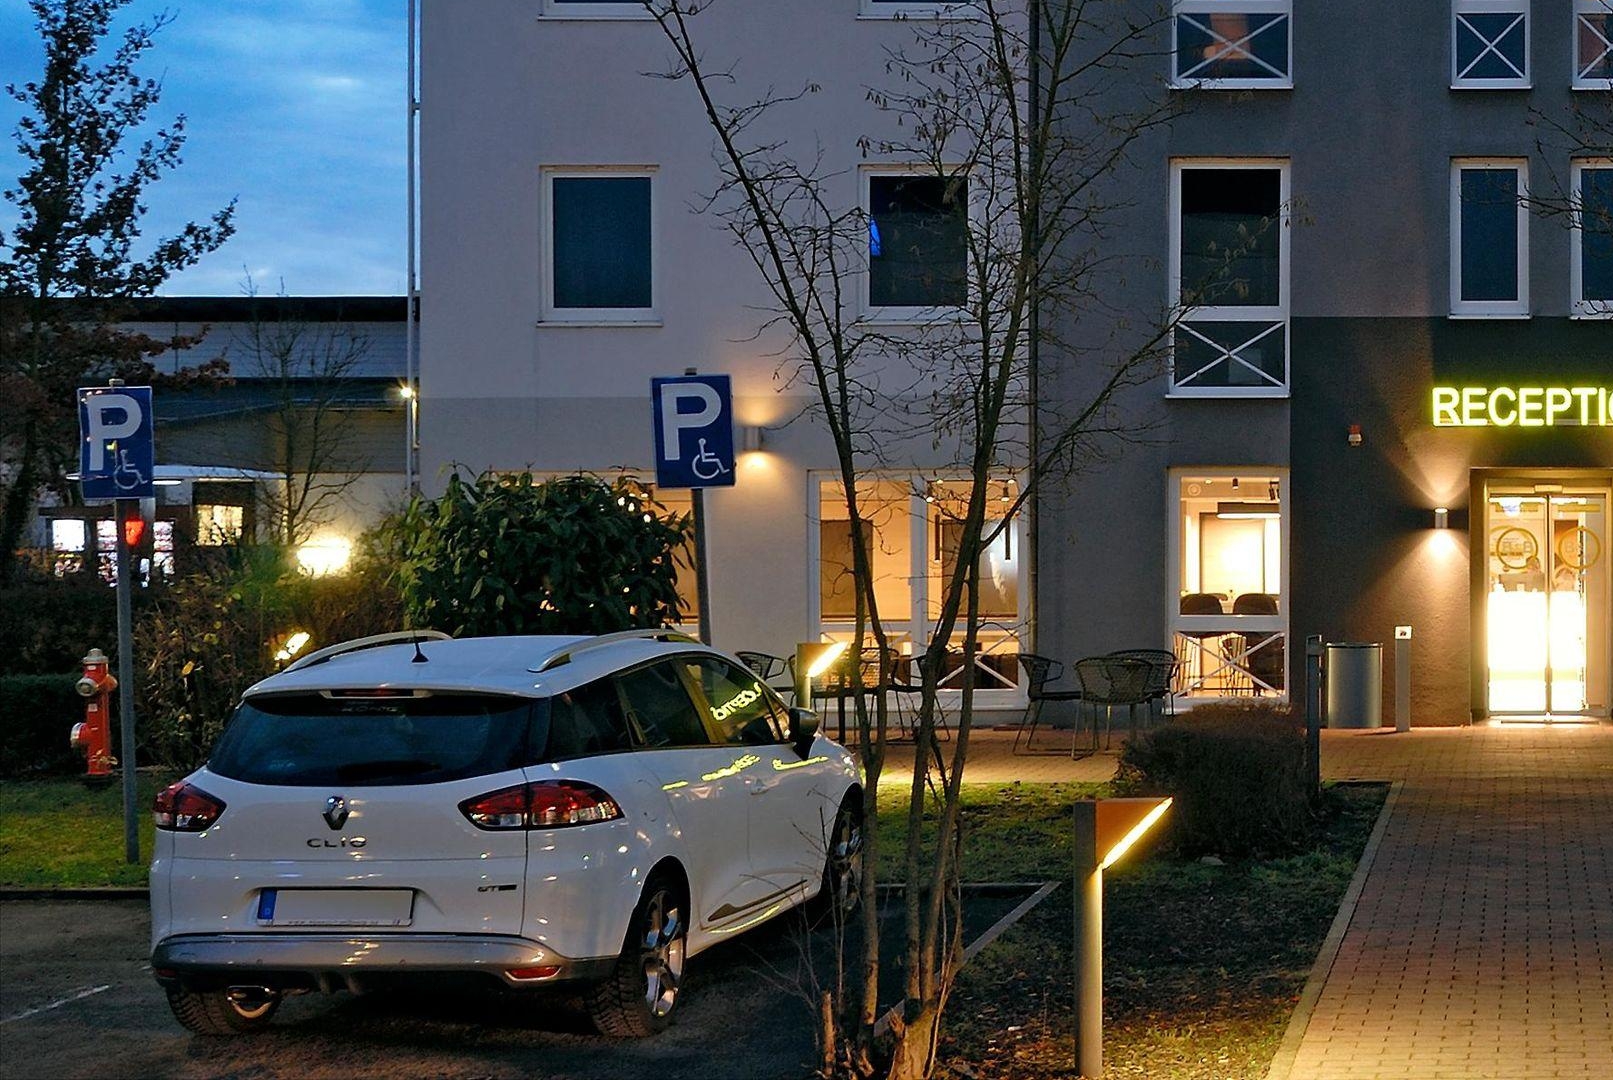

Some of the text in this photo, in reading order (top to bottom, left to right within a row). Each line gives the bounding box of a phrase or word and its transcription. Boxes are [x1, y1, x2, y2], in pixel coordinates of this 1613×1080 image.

[87, 394, 142, 470] P
[661, 382, 721, 460] P
[307, 836, 367, 848] CLIO
